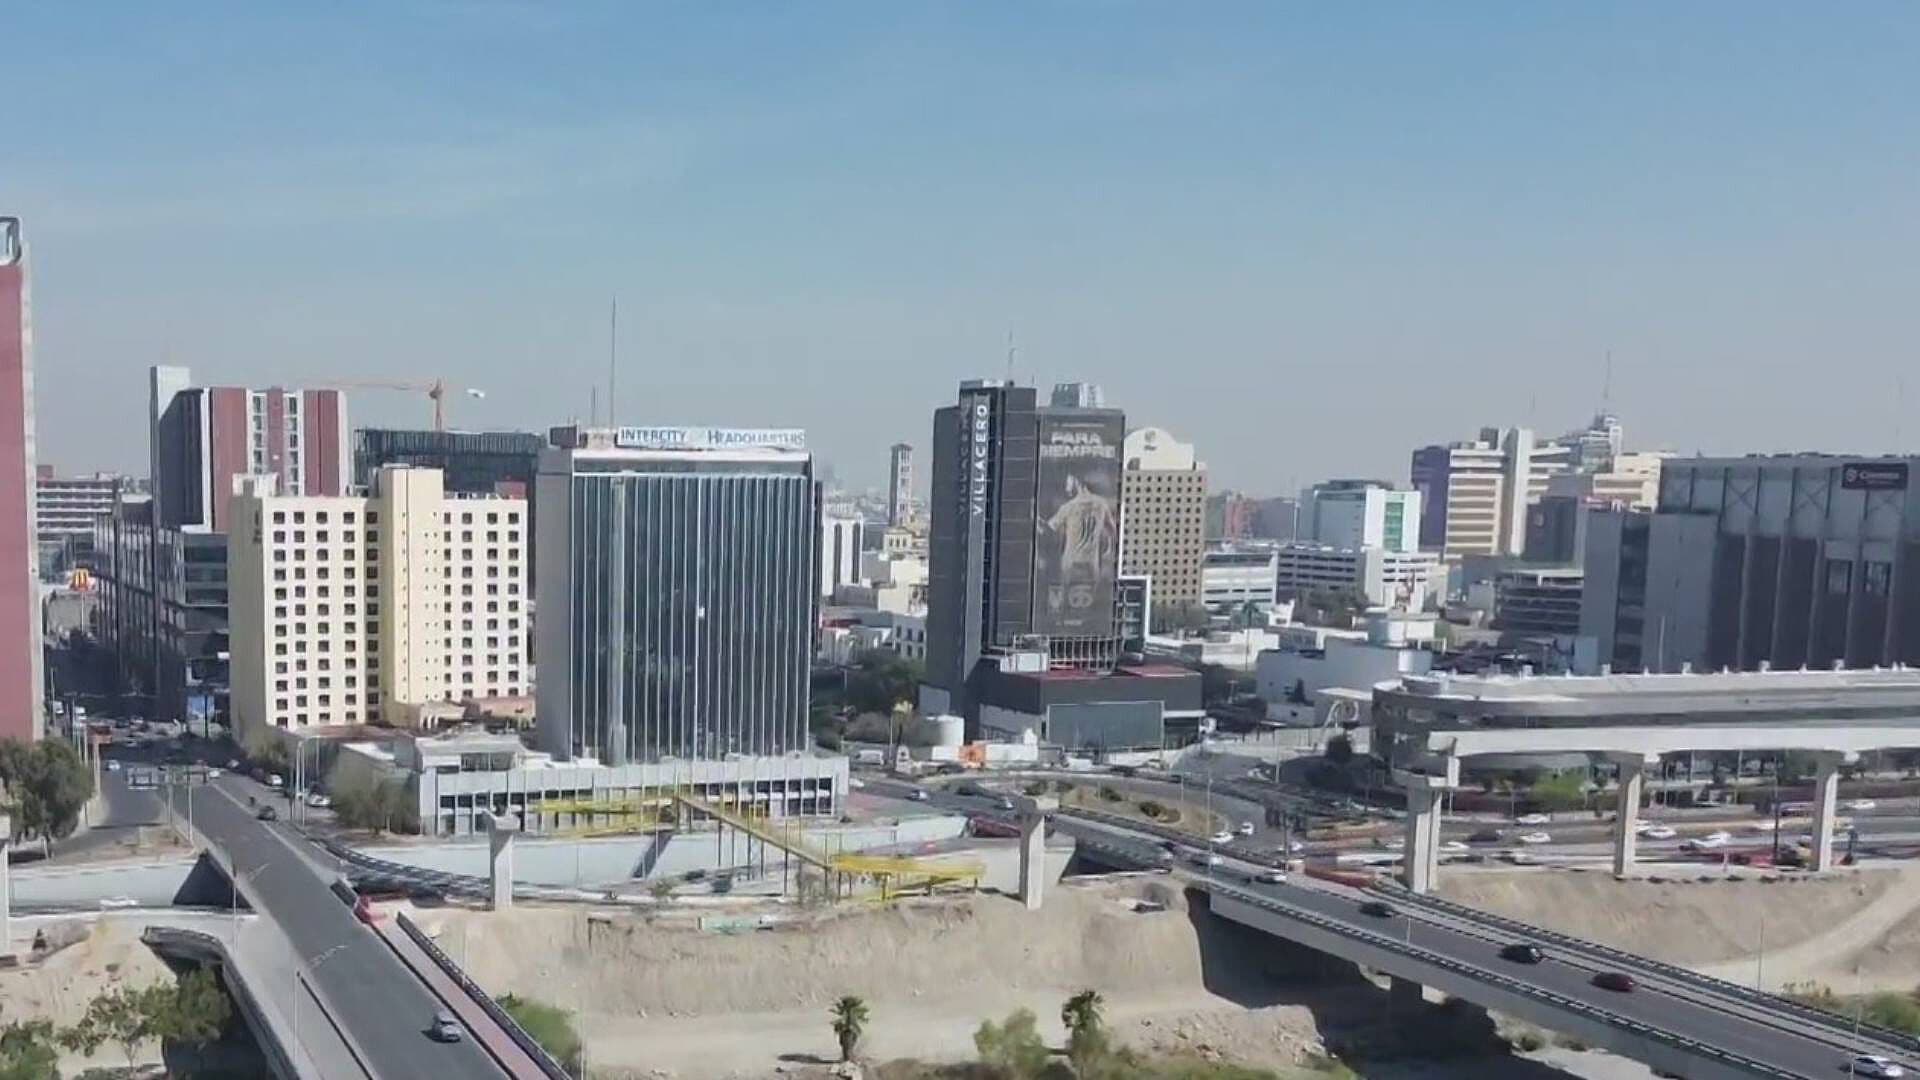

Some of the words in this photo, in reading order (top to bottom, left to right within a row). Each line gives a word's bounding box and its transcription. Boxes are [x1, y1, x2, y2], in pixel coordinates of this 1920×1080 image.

[621, 429, 687, 442] INTERCITY
[708, 429, 805, 445] HEADQUARTERS
[1051, 431, 1103, 444] PARA
[973, 404, 988, 516] VILLACERO
